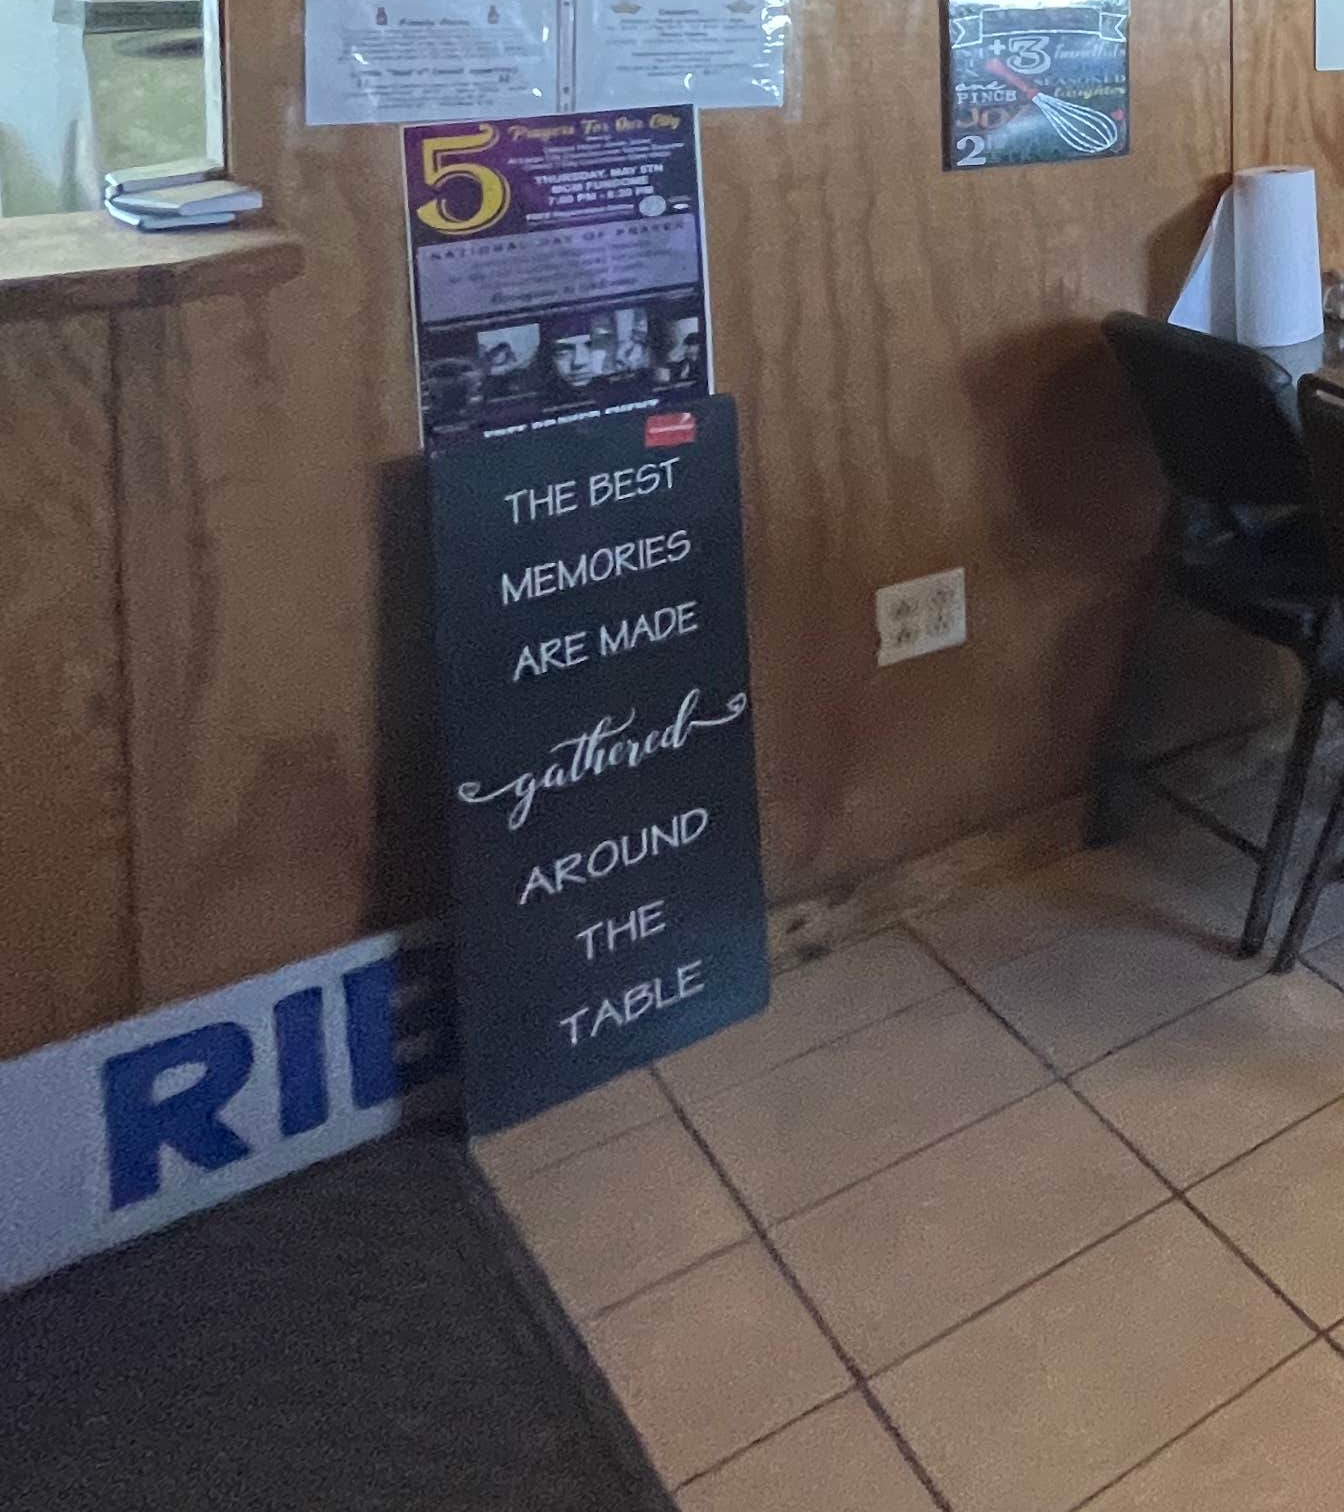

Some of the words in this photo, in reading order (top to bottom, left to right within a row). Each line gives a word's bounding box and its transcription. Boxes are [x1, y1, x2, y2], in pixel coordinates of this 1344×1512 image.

[416, 123, 512, 236] 5
[955, 135, 987, 167] 2
[504, 480, 577, 526] THE
[589, 456, 682, 506] BEST
[500, 529, 692, 607] MEMORIES
[512, 630, 589, 682] ARE
[600, 600, 699, 658] MADE
[457, 687, 748, 832] gathered
[519, 806, 710, 906] AROUND
[574, 899, 667, 962] THE
[557, 958, 707, 1047] TABLE
